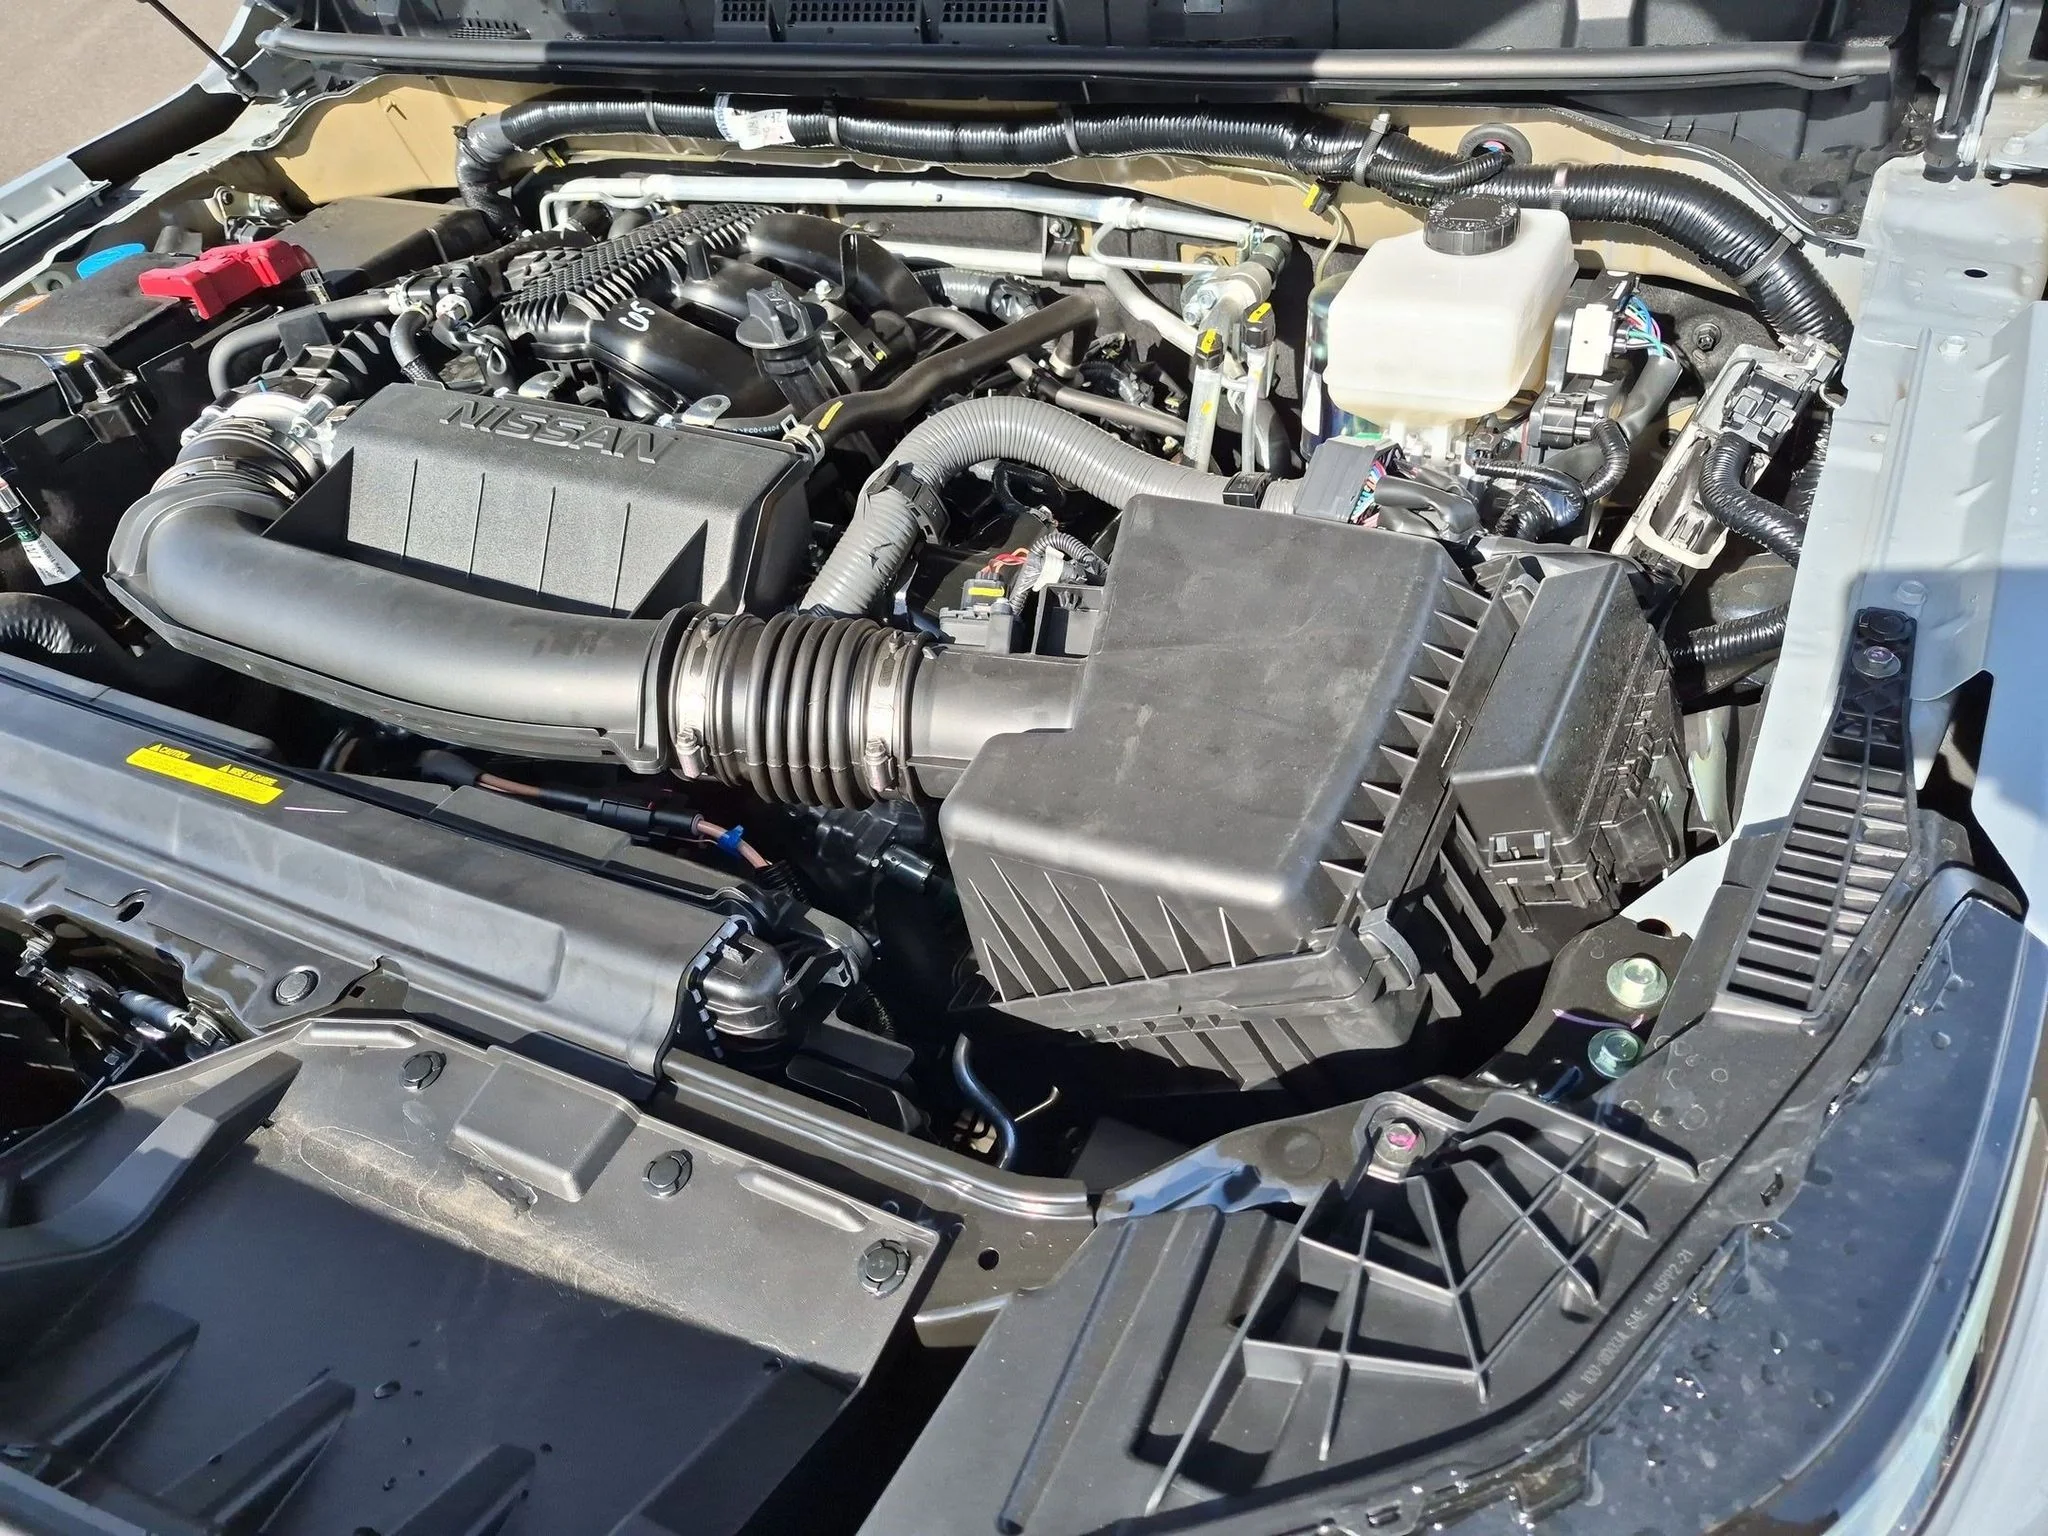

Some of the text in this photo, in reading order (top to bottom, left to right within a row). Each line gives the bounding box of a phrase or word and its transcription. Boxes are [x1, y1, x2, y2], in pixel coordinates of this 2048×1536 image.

[439, 400, 679, 464] NISSAN
[158, 746, 191, 760] CAUTION
[1559, 1390, 1585, 1410] NAL
[1625, 1307, 1649, 1330] SAE
